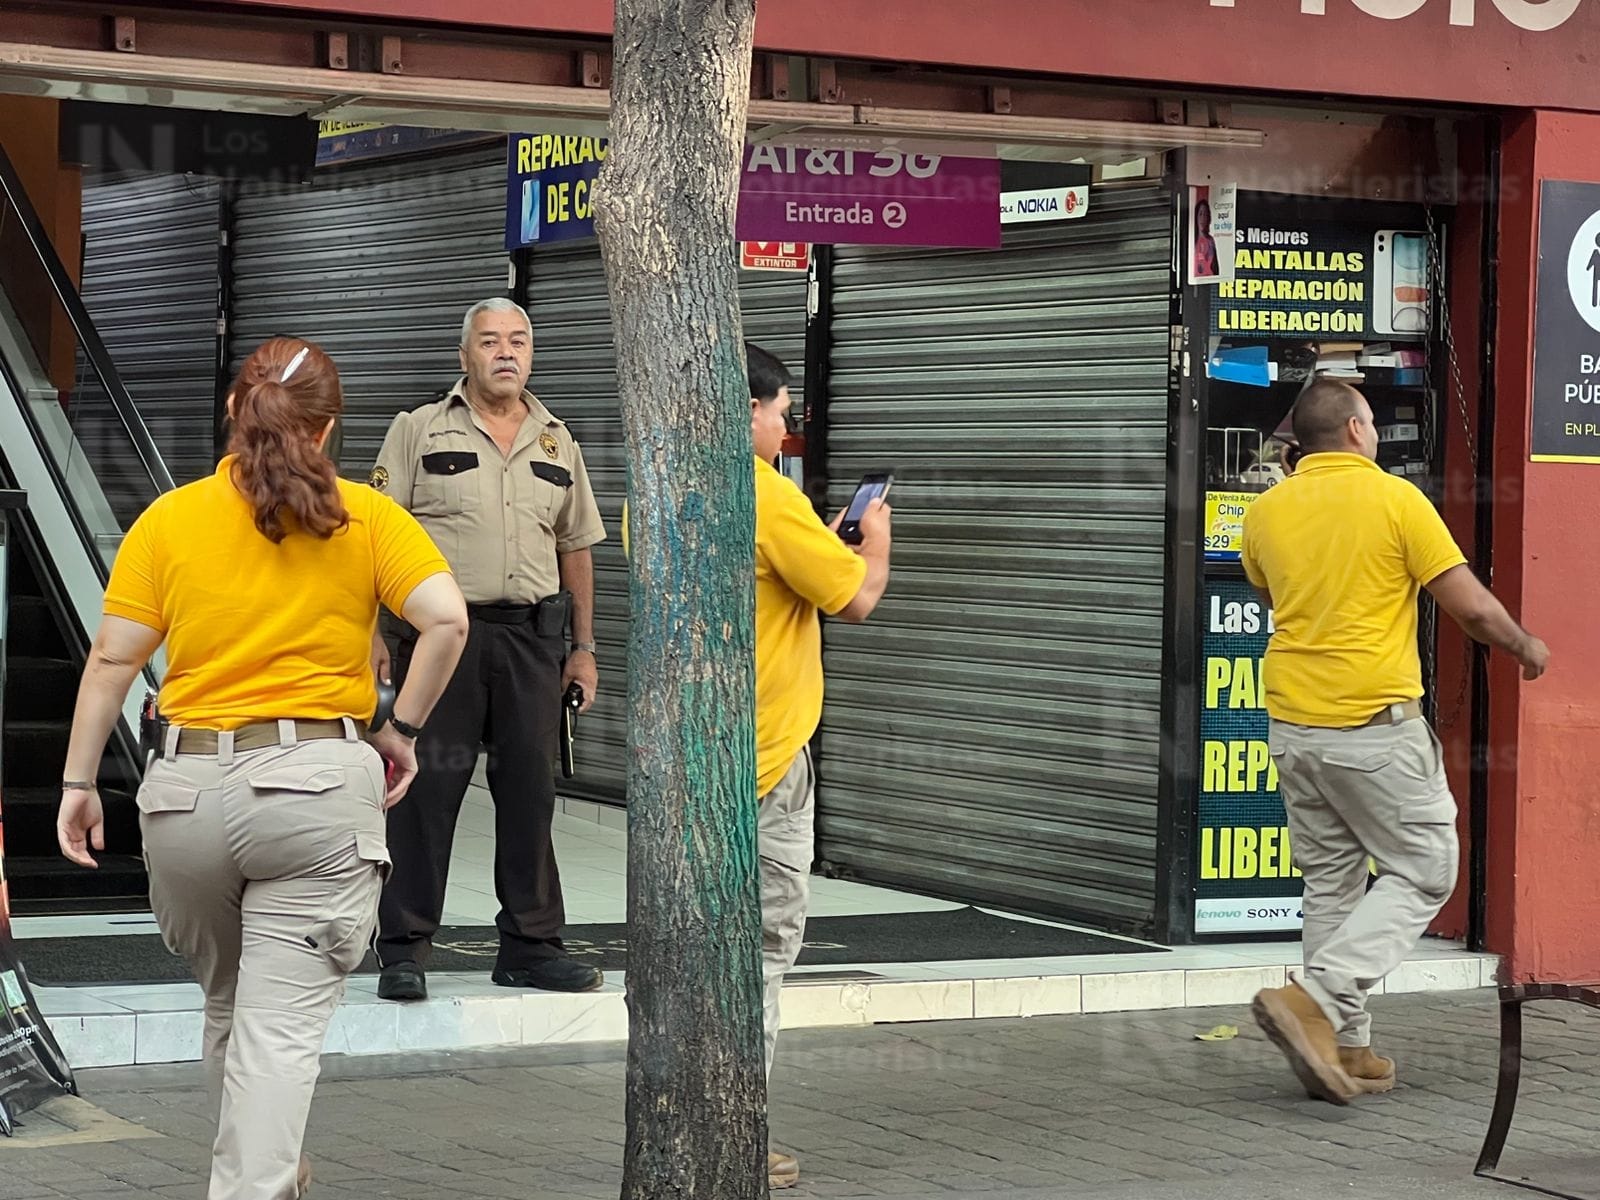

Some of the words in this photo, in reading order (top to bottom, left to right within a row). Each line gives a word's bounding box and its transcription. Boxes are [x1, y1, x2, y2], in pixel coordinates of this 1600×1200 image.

[517, 134, 609, 174] REPARAC
[547, 182, 570, 223] DE
[1017, 197, 1059, 214] NOKIA
[785, 201, 874, 224] Entrada
[885, 203, 904, 225] 2
[1247, 227, 1309, 246] Mejores
[754, 257, 797, 268] EXTINTOR
[1218, 278, 1364, 302] REPARACIÓN
[1218, 309, 1364, 333] LIBERACIÓN
[1565, 422, 1582, 436] EN
[1219, 494, 1239, 502] Venta
[1217, 503, 1245, 519] Chip
[1209, 595, 1260, 634] Las
[1197, 909, 1241, 919] lenovo
[1246, 908, 1291, 919] SONY
